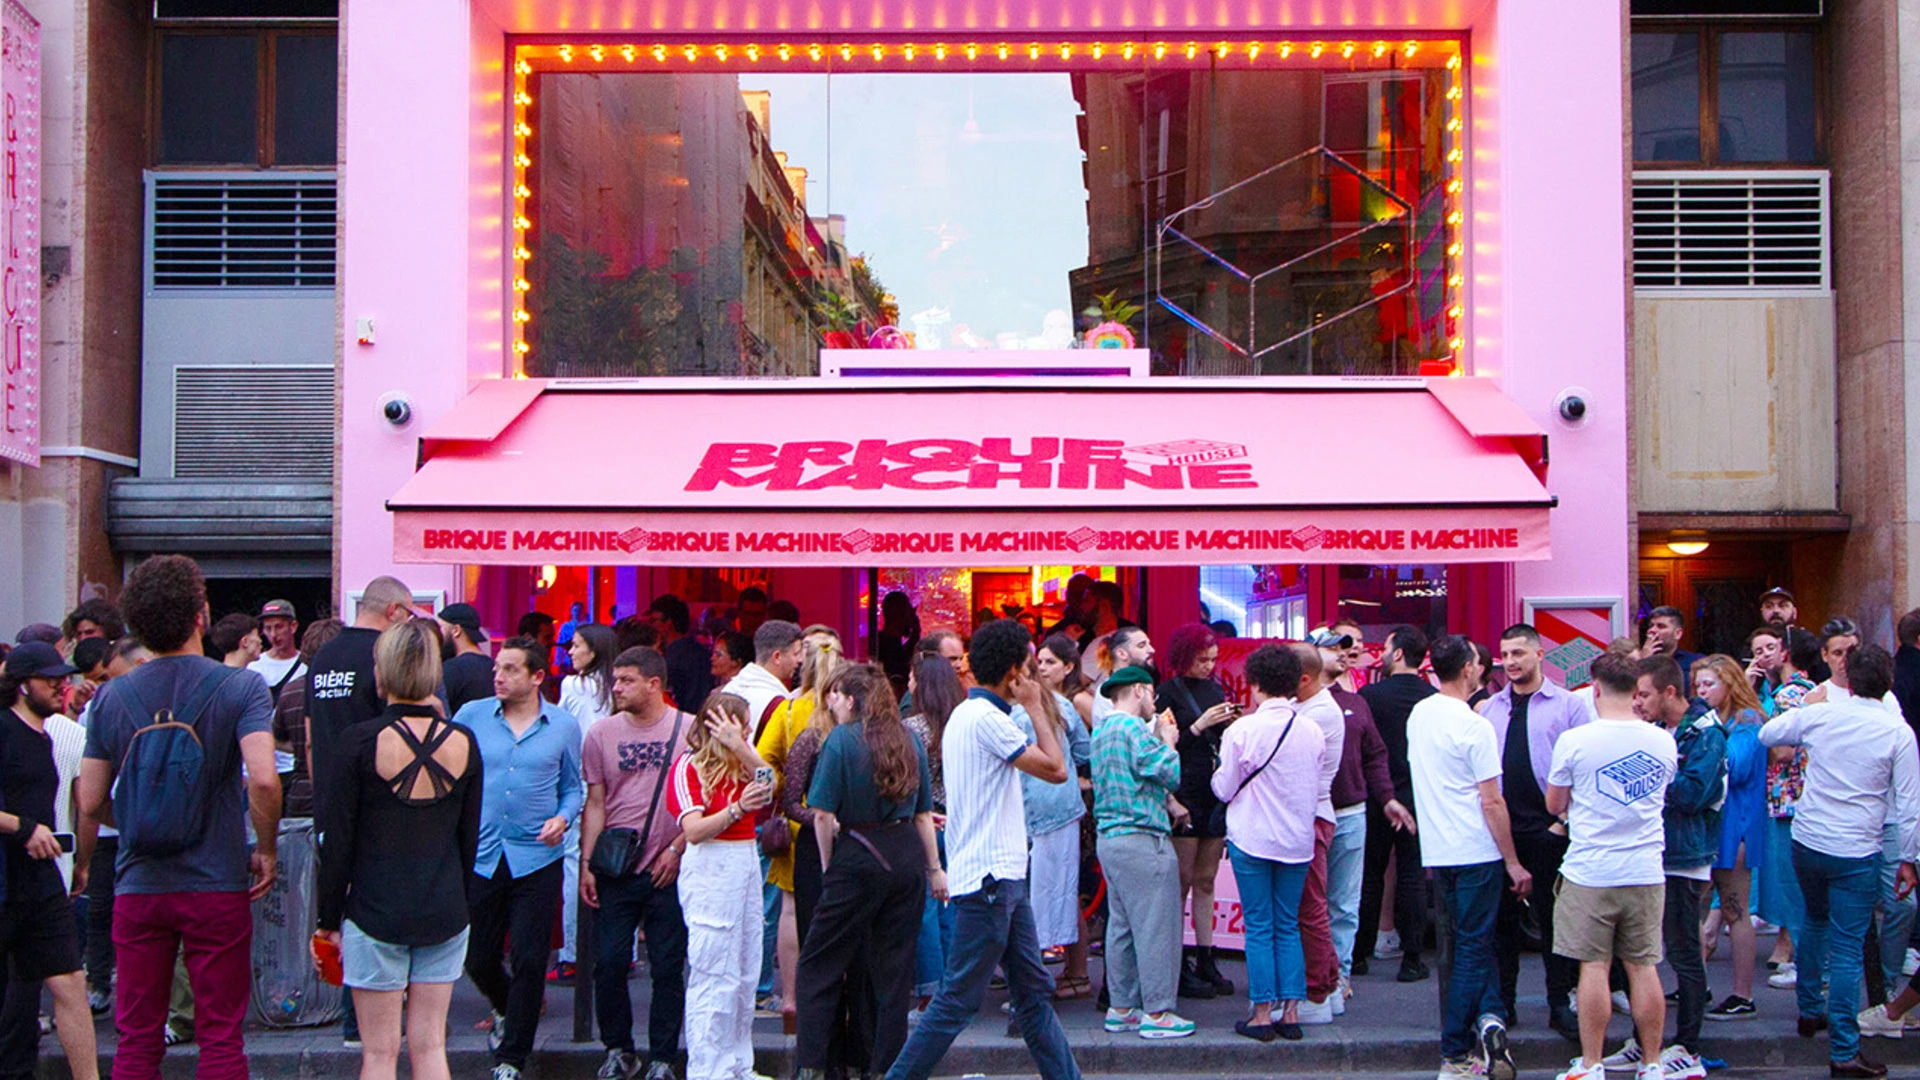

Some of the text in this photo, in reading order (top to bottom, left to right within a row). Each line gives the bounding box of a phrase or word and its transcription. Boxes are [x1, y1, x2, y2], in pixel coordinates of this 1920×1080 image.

[700, 438, 1126, 469] BRIQUE
[1168, 446, 1239, 466] HOUSE
[684, 463, 1258, 491] MACHINE
[424, 530, 506, 551] BRIQUE
[513, 529, 618, 551] MACHINE
[649, 531, 730, 552] BRIQUE
[736, 530, 841, 552] MACHINE
[873, 531, 953, 553] BRIQUE
[960, 530, 1067, 553] MACHINE
[1099, 529, 1179, 551] BRIQUE
[1186, 528, 1292, 551] MACHINE
[1324, 528, 1404, 550] BRIQUE
[1411, 527, 1518, 550] MACHINE
[314, 669, 356, 689] BIÈRE
[1565, 660, 1594, 690] HOU
[1600, 754, 1661, 785] BRIQUE
